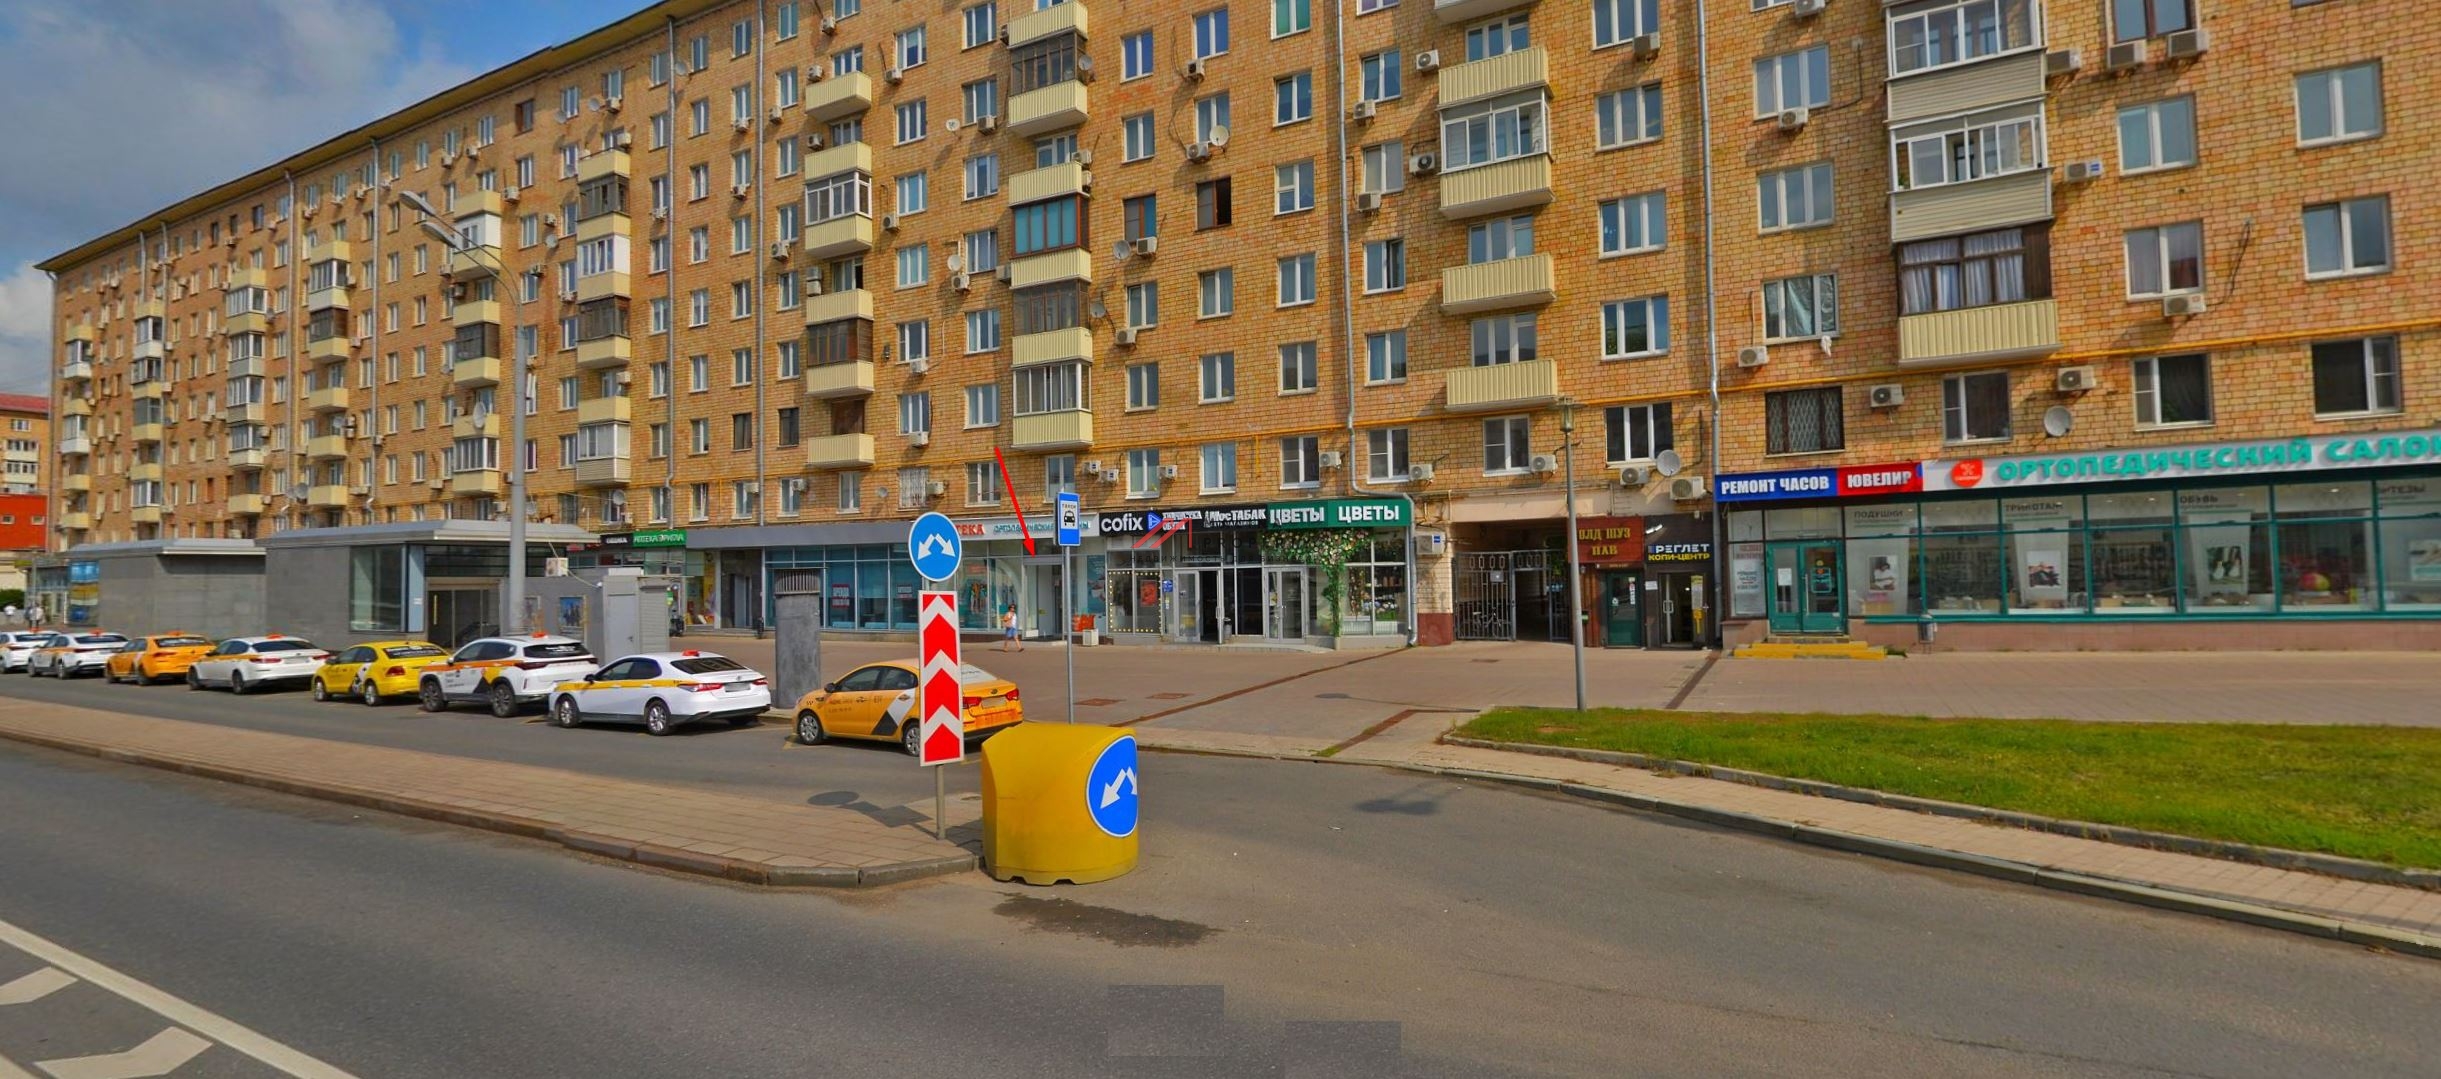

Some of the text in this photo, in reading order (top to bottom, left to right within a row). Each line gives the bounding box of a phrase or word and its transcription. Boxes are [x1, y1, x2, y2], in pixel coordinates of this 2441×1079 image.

[1998, 438, 2313, 481] ОРТОПЕДИЧЕСКИЙ
[1720, 475, 1830, 495] РЕМОНТ ЧАСОВ
[1846, 471, 1912, 489] ЮВЕЛИР
[1101, 512, 1144, 533] cofix
[1269, 507, 1325, 525] ЦВЕТЫ
[1338, 505, 1399, 527] ЦВЕТЫ
[1606, 528, 1631, 539] ШУЗ
[1648, 552, 1711, 561] КОПИ-ЦЕНТР
[1655, 543, 1710, 554] РЕГЛЕТ
